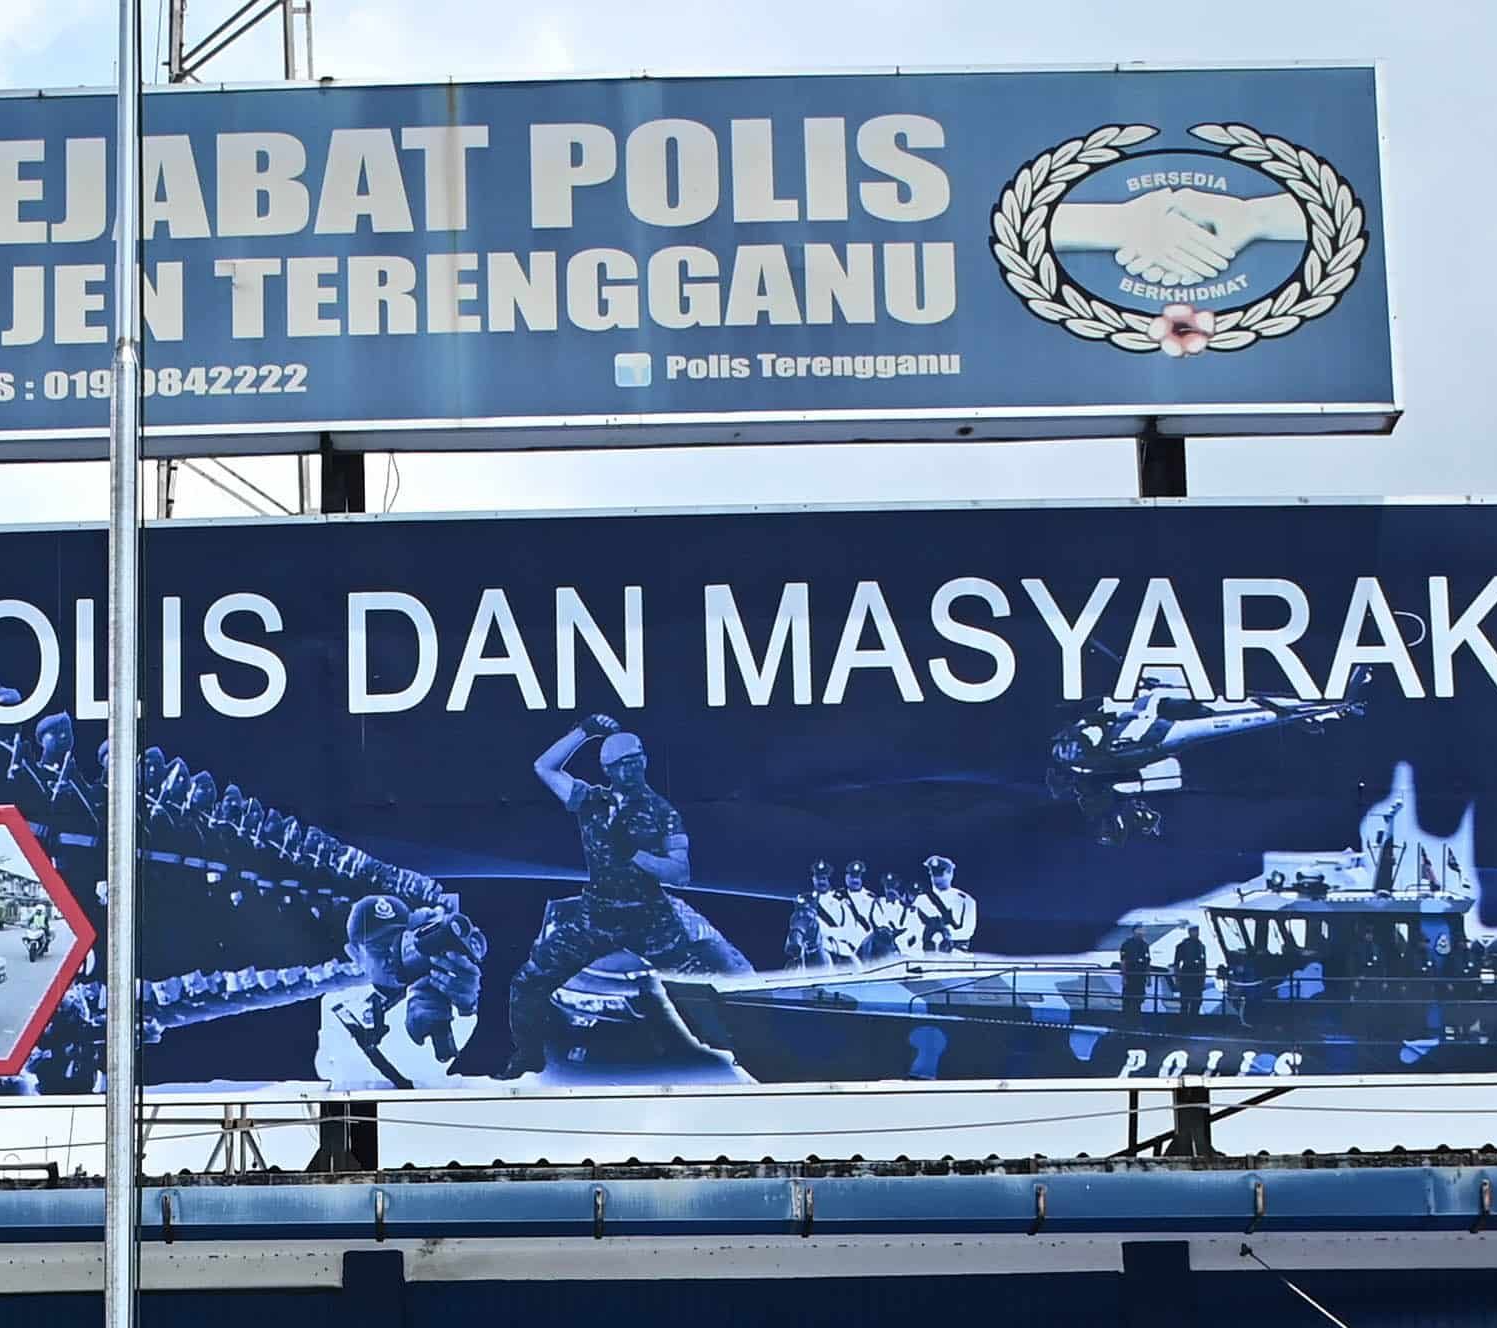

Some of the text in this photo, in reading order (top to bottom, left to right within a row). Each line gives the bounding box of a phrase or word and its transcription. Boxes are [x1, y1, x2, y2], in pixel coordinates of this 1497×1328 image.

[529, 113, 950, 229] POLIS
[1126, 171, 1228, 192] BERSEDIA
[213, 242, 958, 339] TERENGGANU
[1118, 273, 1250, 302] BERKHIDMAT
[666, 352, 961, 380] Polis Terengganu
[346, 585, 647, 716] DAN
